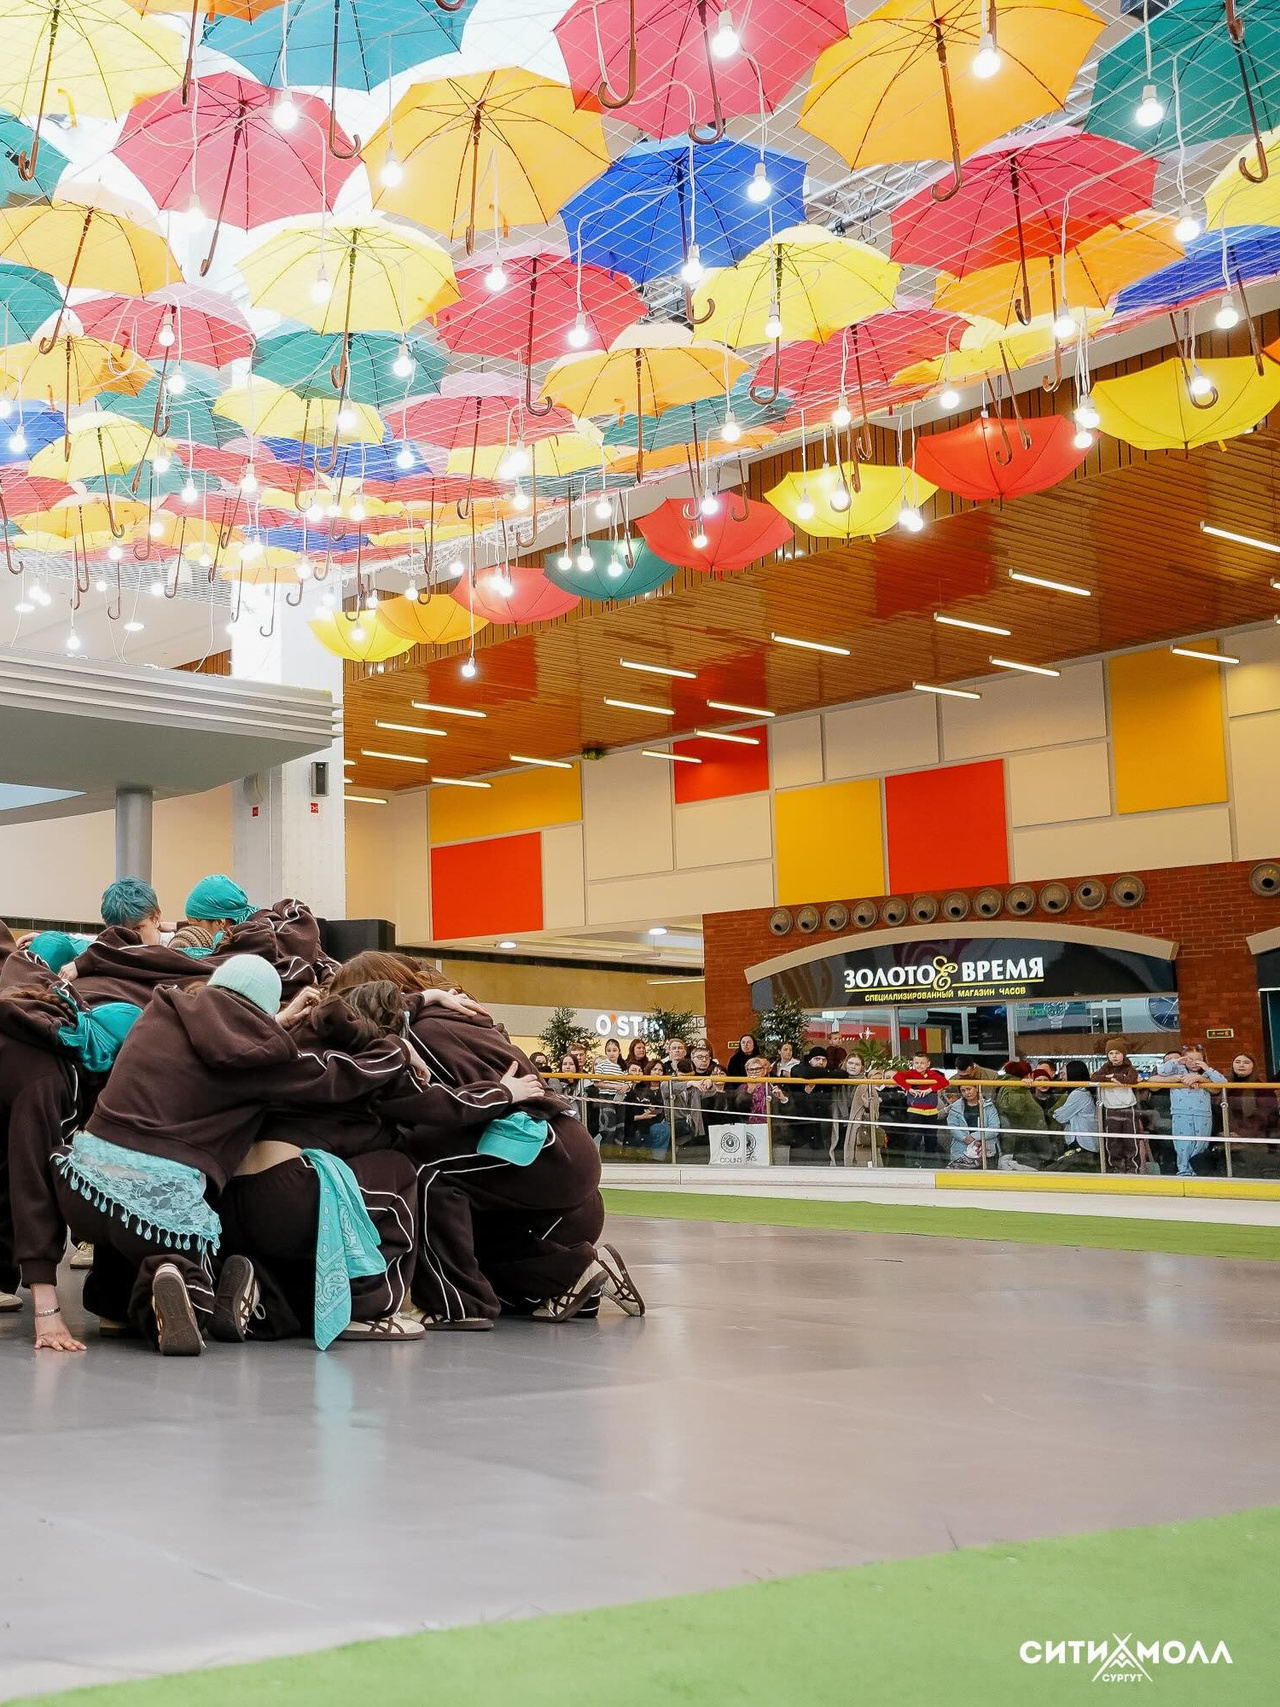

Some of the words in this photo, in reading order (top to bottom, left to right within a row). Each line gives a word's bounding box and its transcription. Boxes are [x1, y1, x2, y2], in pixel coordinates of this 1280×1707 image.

[844, 964, 934, 989] ЗОЛОТО
[961, 956, 1045, 982] ВРЕМЯ
[864, 989, 954, 1002] СПЕЦИАЛИЗИРОВАННЫЙ
[957, 988, 995, 998] МАГАЗИН
[999, 986, 1026, 996] ЧАСОВ
